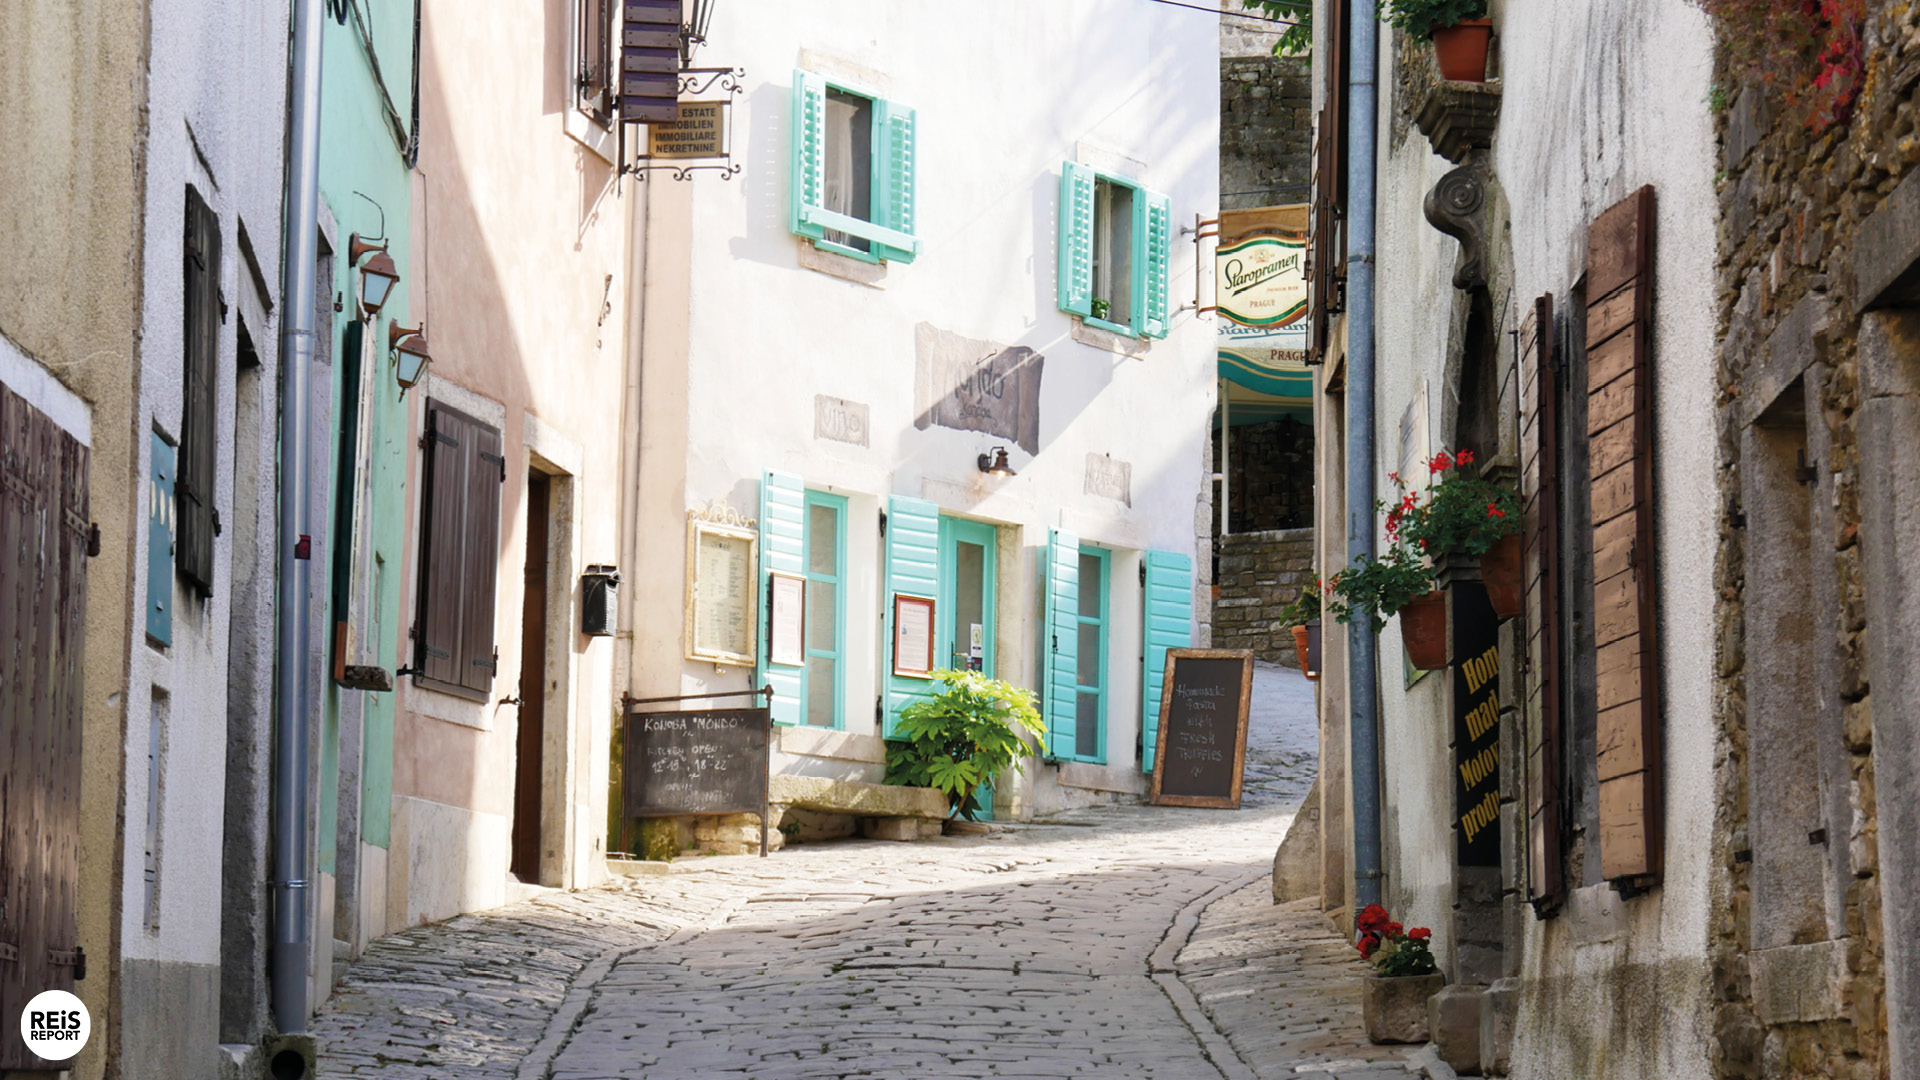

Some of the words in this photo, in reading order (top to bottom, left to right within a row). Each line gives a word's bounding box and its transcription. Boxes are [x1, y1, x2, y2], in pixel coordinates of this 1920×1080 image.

[682, 107, 716, 118] ESTATE
[655, 131, 717, 142] IMMOBILIARE
[656, 143, 716, 153] NEKRETNINE
[1225, 252, 1299, 290] Staropramen
[1249, 299, 1276, 309] PRAGUE
[1462, 645, 1499, 695] Hom
[1465, 689, 1499, 742] mad
[644, 718, 687, 732] KONOBA
